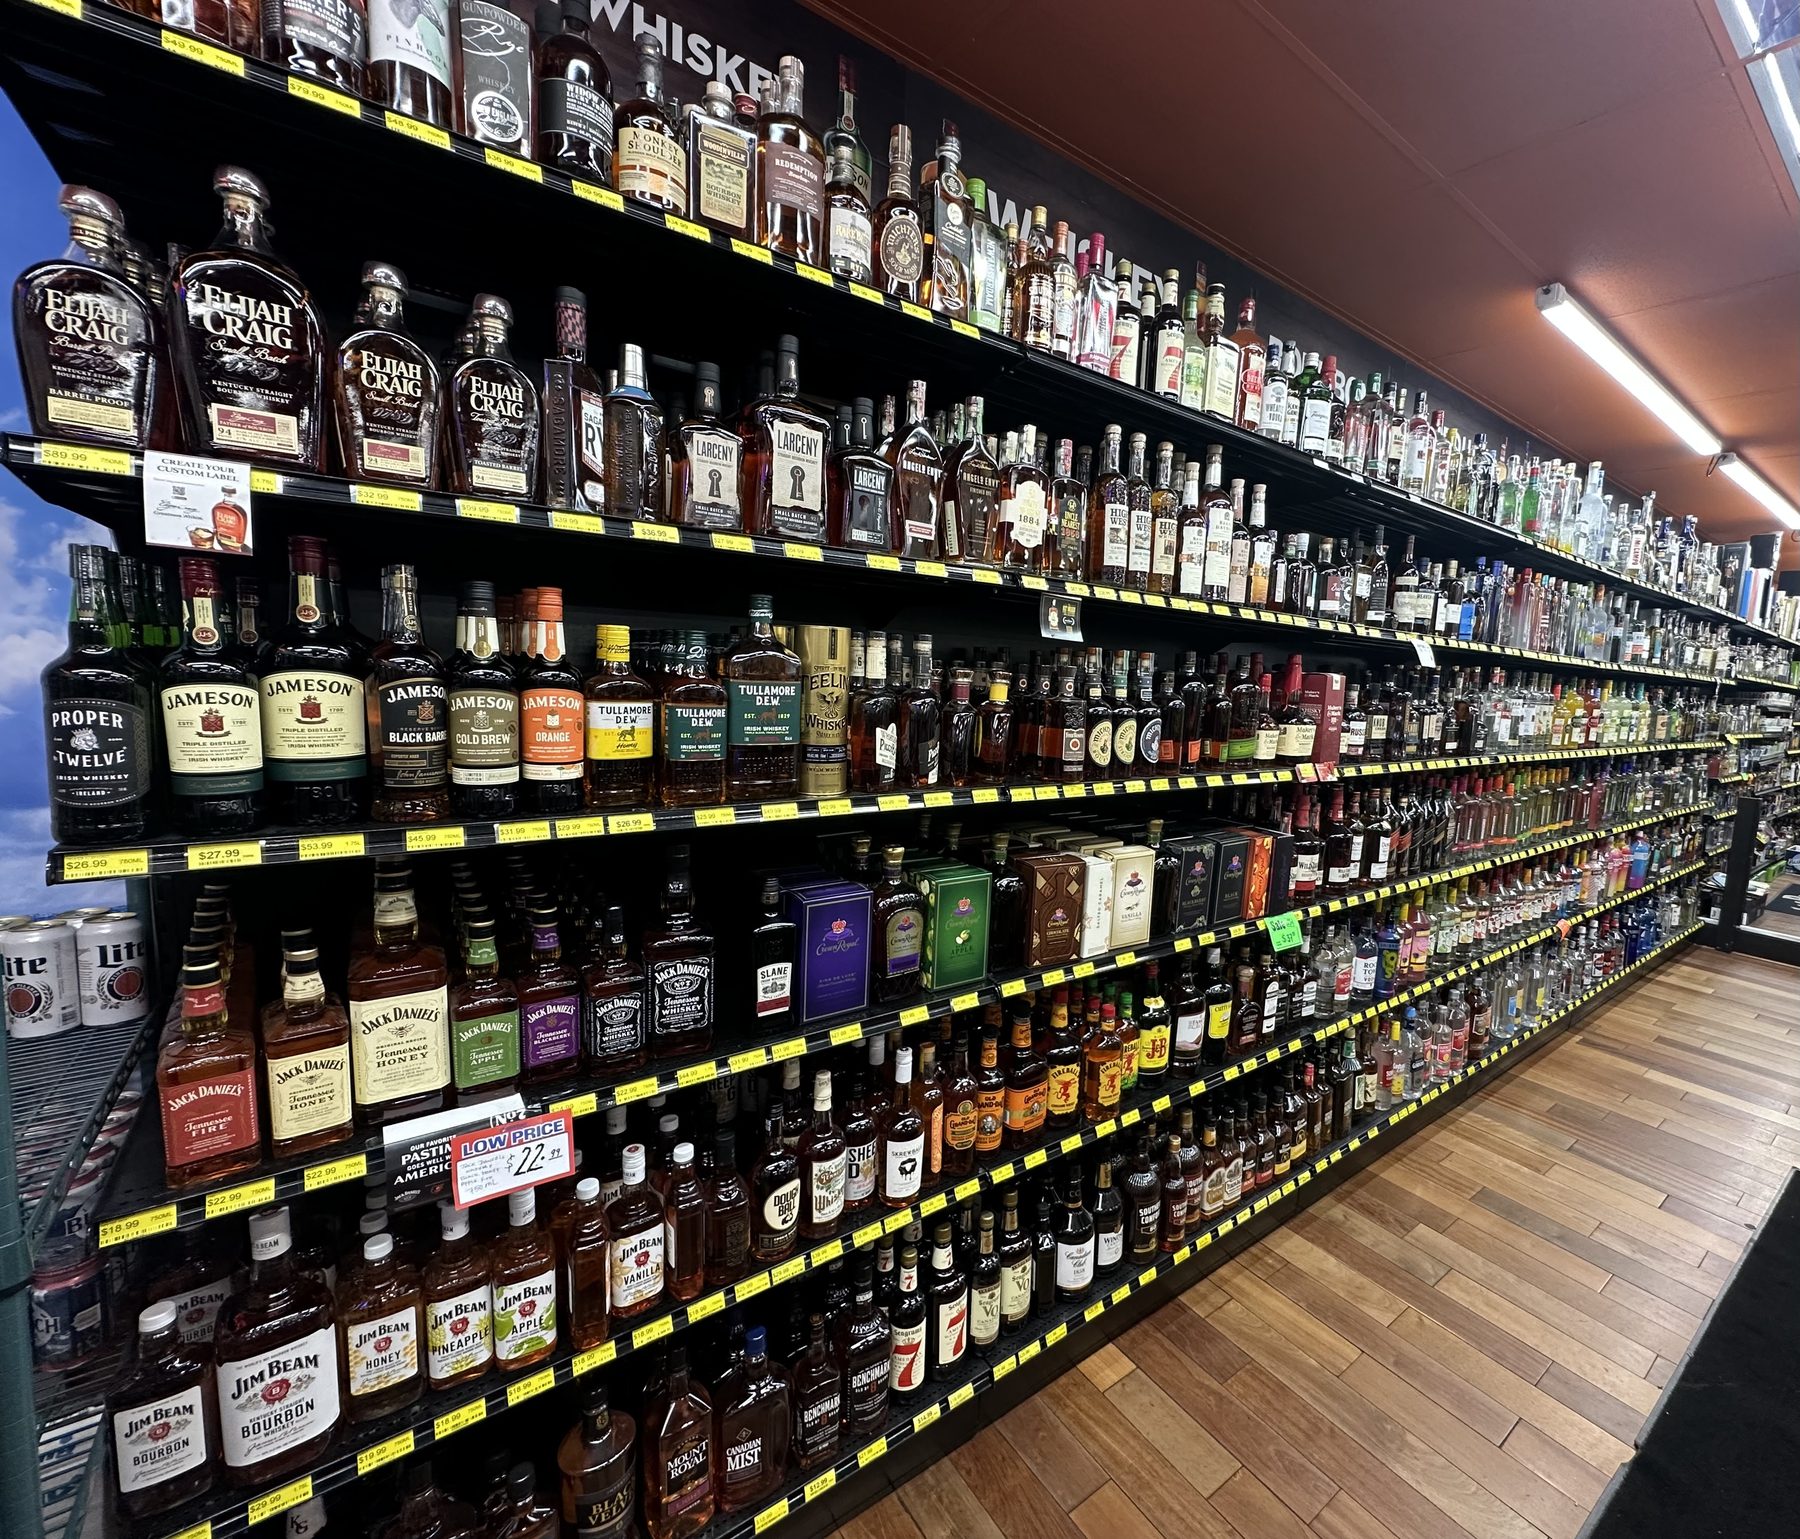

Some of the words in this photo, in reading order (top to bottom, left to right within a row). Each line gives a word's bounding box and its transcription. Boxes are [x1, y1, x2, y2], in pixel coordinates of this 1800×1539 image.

[462, 2, 527, 36] GUNPOWDER
[163, 35, 204, 54] $49.99
[589, 0, 778, 100] WHISKE
[290, 82, 326, 101] $79.99
[477, 75, 516, 95] WHISKEY
[565, 82, 598, 104] WIDOW
[702, 139, 747, 163] WOODINVILLE
[774, 158, 819, 183] REDEMPTION
[706, 183, 742, 200] BOURBON
[706, 189, 742, 207] WHISKEY
[200, 283, 293, 327] ELIJAH
[203, 307, 294, 350] CRAIG
[210, 339, 245, 358] Small
[249, 348, 288, 366] Batch
[360, 350, 423, 381] ELIJAH
[1163, 346, 1182, 390] 7
[211, 379, 254, 393] KENTUCKY
[255, 388, 294, 399] STRAIGHT
[360, 367, 422, 398] CRAIG
[469, 376, 524, 403] ELIJAH
[48, 388, 93, 403] BARREL
[94, 395, 130, 408] PROOF
[365, 390, 393, 405] Small
[393, 397, 420, 409] Batch
[470, 394, 523, 419] CRAIG
[217, 427, 232, 437] 94
[554, 394, 566, 475] SAGAMORE
[696, 439, 735, 463] LARCENY
[777, 428, 819, 458] LARCENY
[43, 449, 88, 463] $89.99
[157, 465, 205, 478] CUSTOM
[206, 472, 240, 483] LABEL
[161, 457, 204, 470] CREATE
[205, 462, 235, 475] YOUR
[473, 459, 500, 469] TOASTED
[500, 462, 526, 473] BARREL
[853, 468, 886, 492] LARCENY
[357, 491, 390, 501] $32.99
[774, 509, 790, 518] SMALL
[1018, 514, 1040, 525] 1884
[1064, 510, 1080, 523] UNCLE
[1110, 508, 1128, 518] HIG
[641, 528, 667, 538] $36.99
[1061, 518, 1080, 530] NEAREST
[266, 678, 355, 698] JAMESON
[738, 684, 796, 696] TULLAMORE
[801, 674, 849, 692] TEELIN
[166, 691, 254, 711] JAMESON
[522, 694, 582, 712] JAMESON
[755, 695, 781, 706] D.E.W.
[52, 709, 124, 729] PROPER
[598, 704, 652, 716] TULLAMORE
[675, 707, 726, 718] TULLAMORE
[281, 726, 306, 734] TRIPLE
[307, 726, 344, 734] DISTILLED
[389, 730, 424, 744] BLACK
[424, 729, 448, 743] BARRE
[456, 733, 480, 745] COLD
[480, 732, 511, 745] BREW
[535, 730, 571, 743] ORANGE
[307, 742, 341, 750] WHISKEY
[616, 741, 639, 751] Honey
[57, 749, 127, 769] TWELVE
[210, 755, 244, 763] WHISKEY
[75, 788, 108, 797] IRELAND
[500, 826, 526, 836] $31.99
[615, 818, 642, 829] $26.99
[300, 841, 333, 851] $53.99
[407, 833, 437, 843] $45.99
[198, 849, 240, 861] $27.99
[66, 858, 109, 871] $26.99
[1119, 888, 1133, 899] Crown
[1132, 884, 1146, 896] Royal
[1121, 911, 1143, 920] VANILLA
[1270, 921, 1287, 932] Sale
[96, 942, 146, 968] Lite
[654, 967, 676, 985] JACK
[675, 963, 710, 977] DANIEL'S
[760, 966, 789, 979] SLANE
[595, 1002, 616, 1018] JACK
[615, 998, 642, 1010] DANIEL'S
[661, 1003, 703, 1016] WHISKEY
[663, 994, 701, 1007] Tennessee
[361, 1015, 391, 1036] JACK
[392, 1006, 441, 1023] DANIEL'S
[526, 1009, 549, 1024] JACK
[549, 1004, 577, 1016] DANIEL'S
[533, 1032, 571, 1045] BLACKBERRY
[376, 1052, 429, 1068] HONEY
[470, 1048, 504, 1061] Tennessee
[470, 1054, 504, 1066] APPLE
[1051, 1066, 1080, 1080] FIREBALL
[168, 1090, 199, 1112] JACK
[198, 1083, 244, 1099] DANIEL'S
[191, 1123, 228, 1138] FIRE
[462, 1134, 508, 1159] LOW
[512, 1119, 566, 1145] PRICE
[410, 1143, 426, 1152] OUR
[407, 1162, 426, 1172] GOES
[426, 1156, 445, 1168] WELL
[306, 1166, 337, 1182] $22.99
[207, 1191, 242, 1208] $22.99
[773, 1188, 800, 1208] DOUGH
[778, 1201, 797, 1217] BALL
[100, 1219, 140, 1238] $18.99
[149, 1211, 173, 1223] 750ML
[619, 1245, 639, 1263] JIM
[638, 1236, 663, 1249] BEAM
[1065, 1249, 1092, 1261] Canadian
[1072, 1257, 1087, 1269] Club
[622, 1263, 662, 1286] VANILLA
[510, 1314, 545, 1336] APPLE
[355, 1330, 378, 1349] JIM
[378, 1322, 410, 1335] BEAM
[431, 1325, 490, 1356] PINEAPPLE
[365, 1350, 401, 1371] HONEY
[231, 1372, 266, 1401] JIM
[267, 1353, 320, 1378] BEAM
[852, 1358, 891, 1389] BENCHMARK
[869, 1381, 878, 1394] 8
[804, 1394, 841, 1424] BENCHMARK
[124, 1415, 151, 1439] JIM
[152, 1403, 195, 1422] BEAM
[241, 1398, 315, 1440] BOURBON
[133, 1437, 191, 1467] BOURBON
[358, 1446, 387, 1465] $19.99
[667, 1439, 709, 1472] MOUNT
[726, 1437, 762, 1458] CANADIAN
[670, 1451, 707, 1480] ROYAL
[726, 1446, 762, 1473] MIST
[249, 1494, 282, 1514] $29.99
